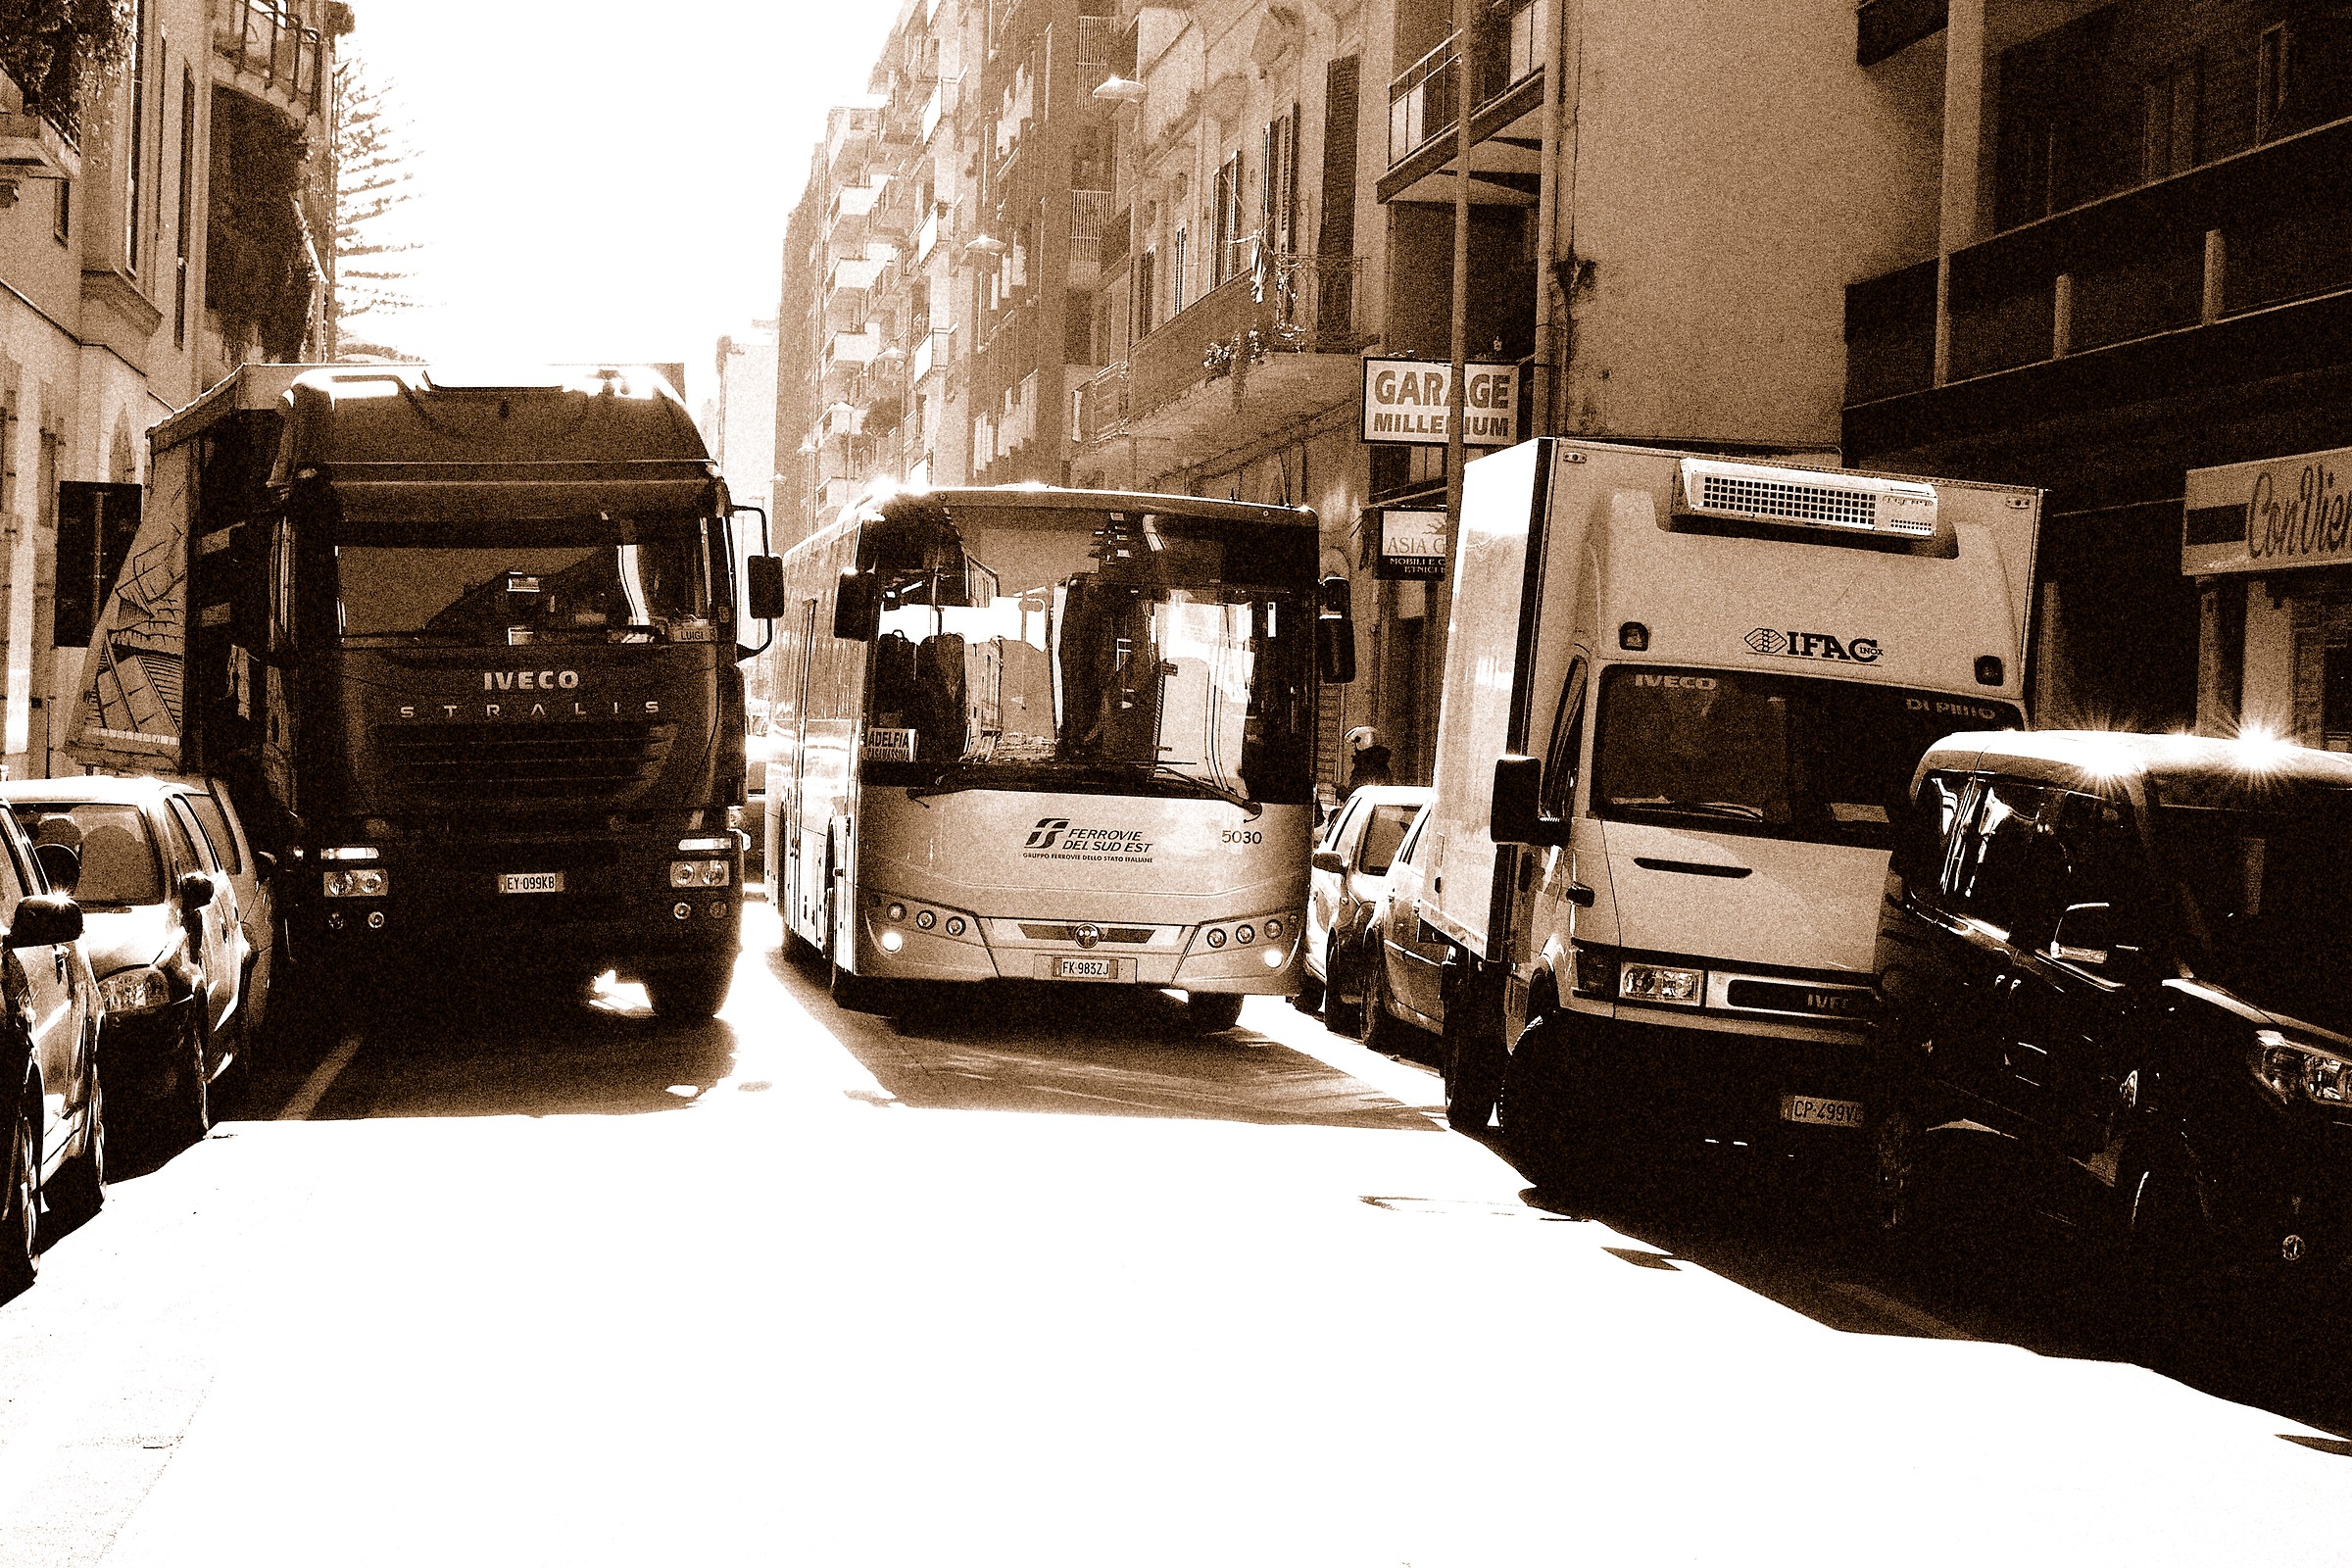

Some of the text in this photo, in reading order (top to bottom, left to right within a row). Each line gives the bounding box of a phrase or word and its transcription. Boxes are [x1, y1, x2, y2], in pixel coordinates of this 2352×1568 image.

[1373, 413, 1509, 437] MILLEIUM
[1387, 537, 1446, 555] ASIA G
[680, 630, 704, 641] LUIGI
[1786, 630, 1879, 663] IFAC
[1859, 646, 1884, 657] INOX
[483, 670, 579, 691] IVECO
[1635, 673, 1717, 690] IVECO
[400, 701, 660, 718] STRALIS
[867, 731, 909, 748] ADELFIA
[1068, 828, 1144, 841] FERROVIE
[1221, 829, 1262, 844] 5030
[1061, 840, 1153, 854] DEL SUD EST
